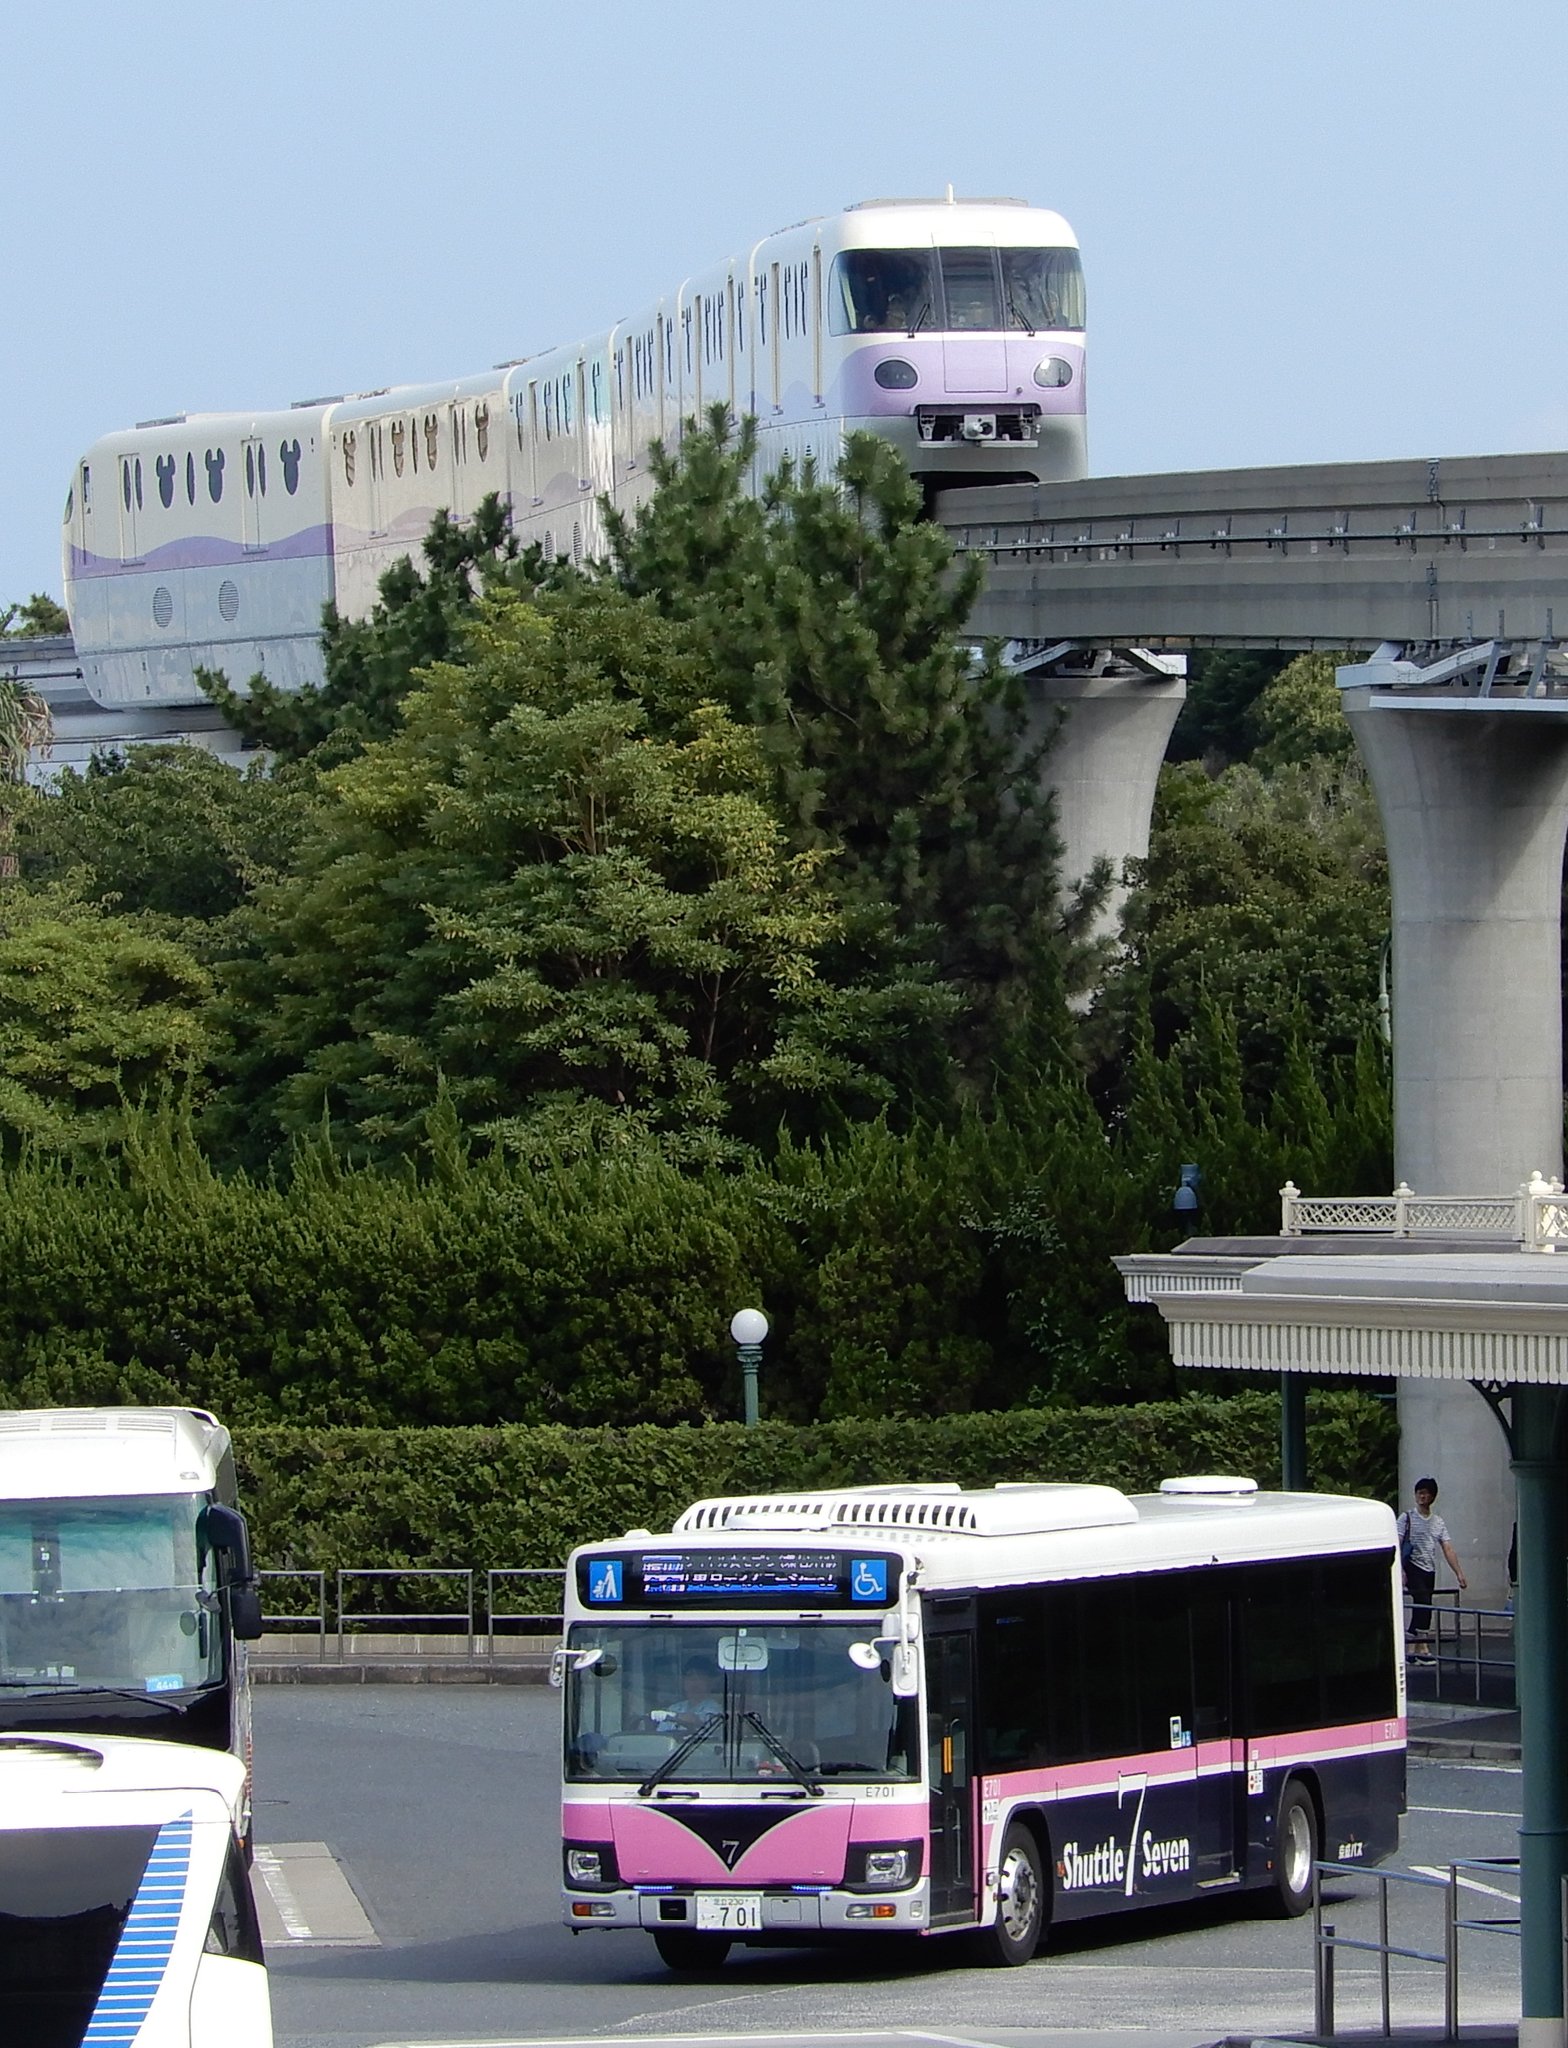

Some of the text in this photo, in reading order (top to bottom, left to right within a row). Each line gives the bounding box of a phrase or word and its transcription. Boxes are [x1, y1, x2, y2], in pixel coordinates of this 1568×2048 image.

[866, 1787, 895, 1798] E701
[984, 1779, 1001, 1798] E701
[1063, 1771, 1190, 1896] Shuttle 7 Seven
[722, 1840, 740, 1865] 7
